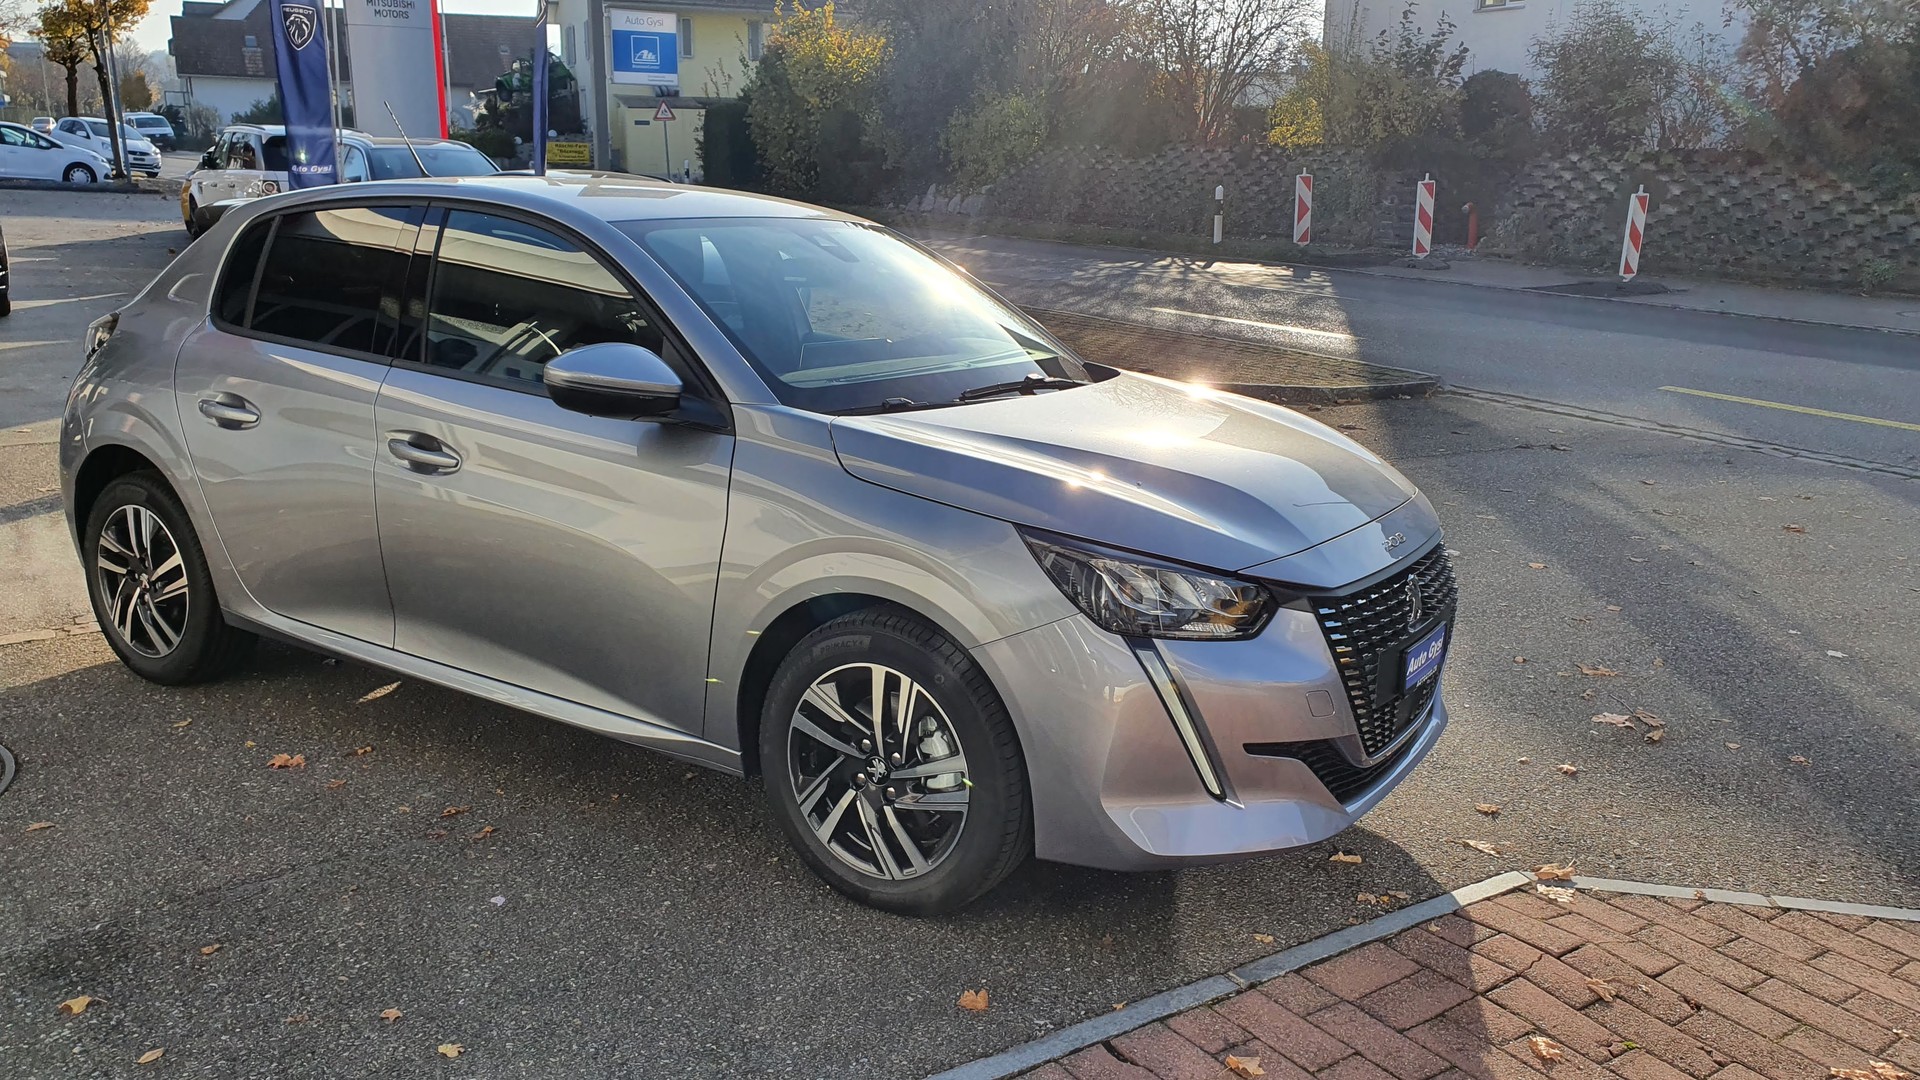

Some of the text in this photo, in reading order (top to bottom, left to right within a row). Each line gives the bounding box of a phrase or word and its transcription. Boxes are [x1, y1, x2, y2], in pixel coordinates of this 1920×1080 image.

[366, 0, 416, 9] MITSUBISHI
[283, 7, 313, 15] PEUGEOT
[374, 9, 410, 19] MOTORS
[625, 16, 664, 27] Auto Gysi
[1382, 532, 1407, 552] 208
[819, 639, 858, 654] PRIMACY
[1406, 651, 1428, 676] Auto
[1428, 632, 1445, 659] Gysi
